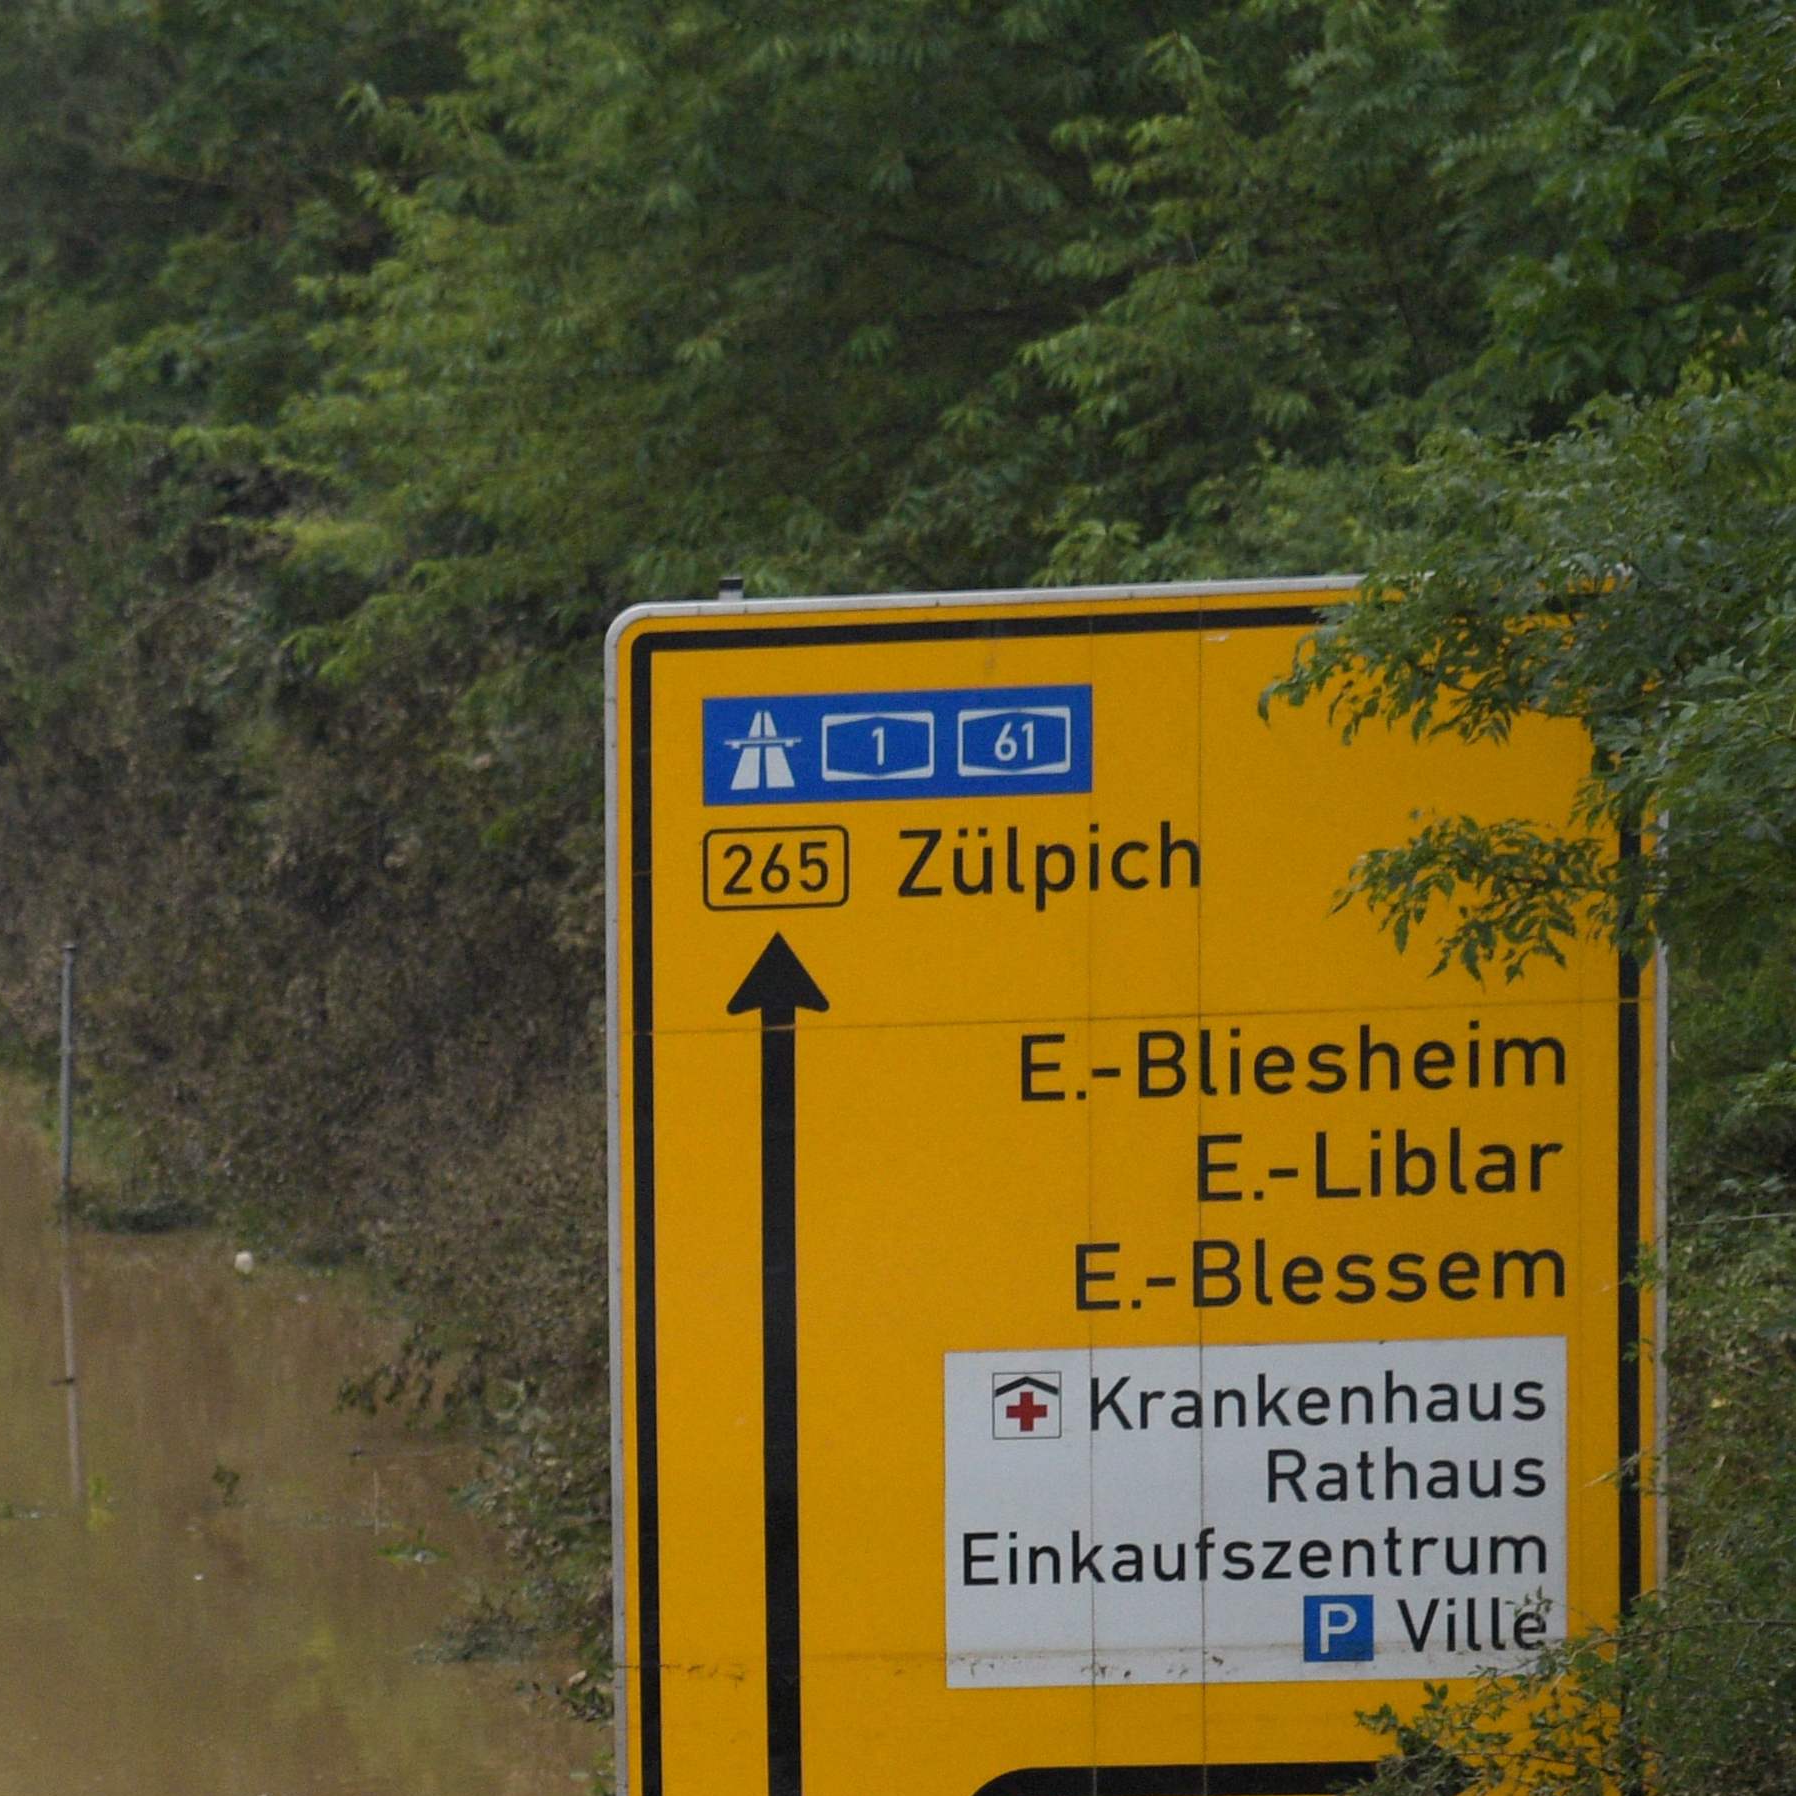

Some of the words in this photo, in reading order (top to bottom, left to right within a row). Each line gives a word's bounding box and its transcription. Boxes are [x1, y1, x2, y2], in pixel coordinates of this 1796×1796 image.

[870, 727, 886, 764] 1
[993, 722, 1036, 762] 61
[723, 842, 829, 894] 265
[898, 821, 1201, 912] Zülpich
[1020, 1020, 1565, 1101] E.-Bliesheim
[1197, 1128, 1563, 1202] E.-Liblar
[1075, 1239, 1565, 1311] E.-Blessem
[1090, 1371, 1546, 1431] Krankenhaus
[1268, 1447, 1546, 1502] Rathaus
[963, 1527, 1547, 1586] Einkaufszentrum
[1397, 1597, 1547, 1652] Ville
